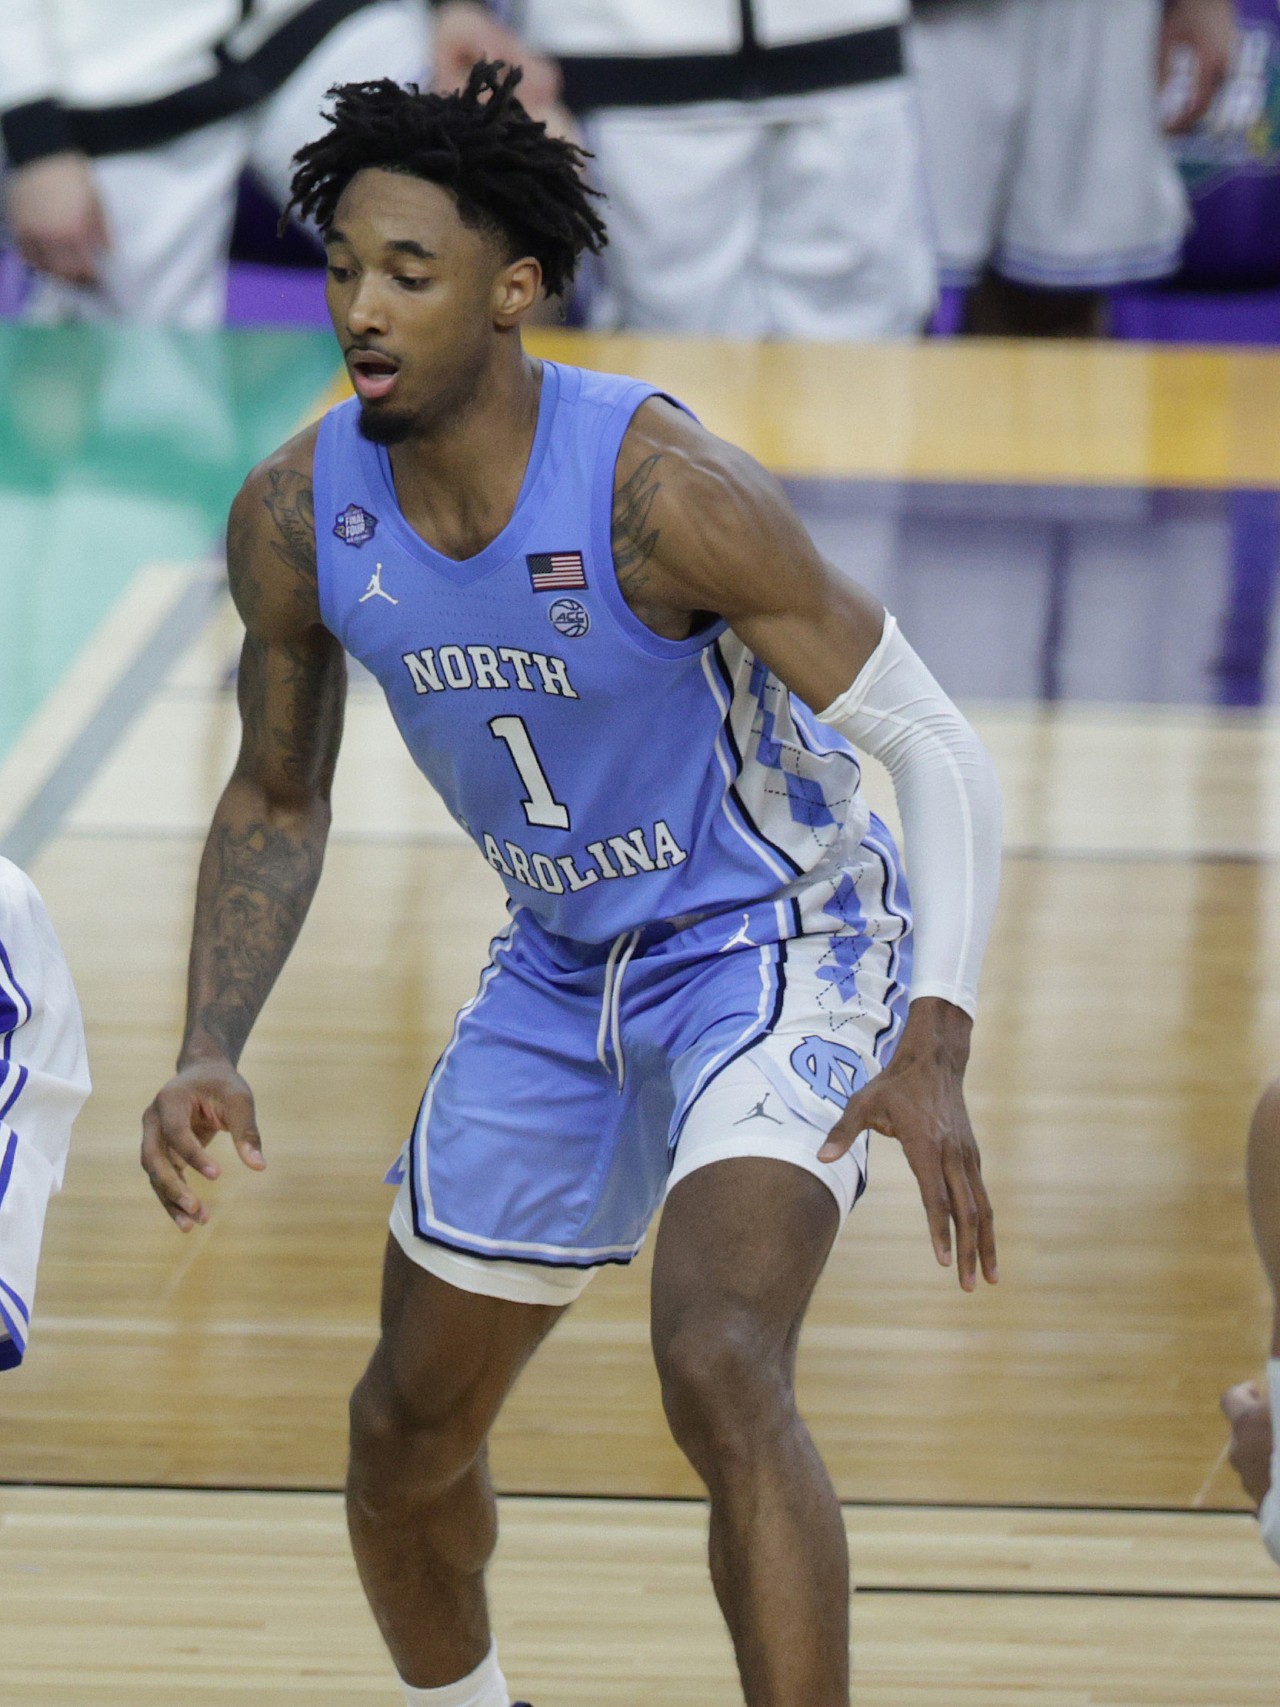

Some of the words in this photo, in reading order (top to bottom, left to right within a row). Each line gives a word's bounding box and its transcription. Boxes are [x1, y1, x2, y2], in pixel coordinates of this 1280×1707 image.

[345, 513, 365, 526] FINAL
[346, 524, 366, 538] FOUR
[556, 611, 585, 623] ACC
[402, 644, 580, 699] NORTH
[486, 714, 571, 831] 1
[460, 820, 687, 895] AROLINA
